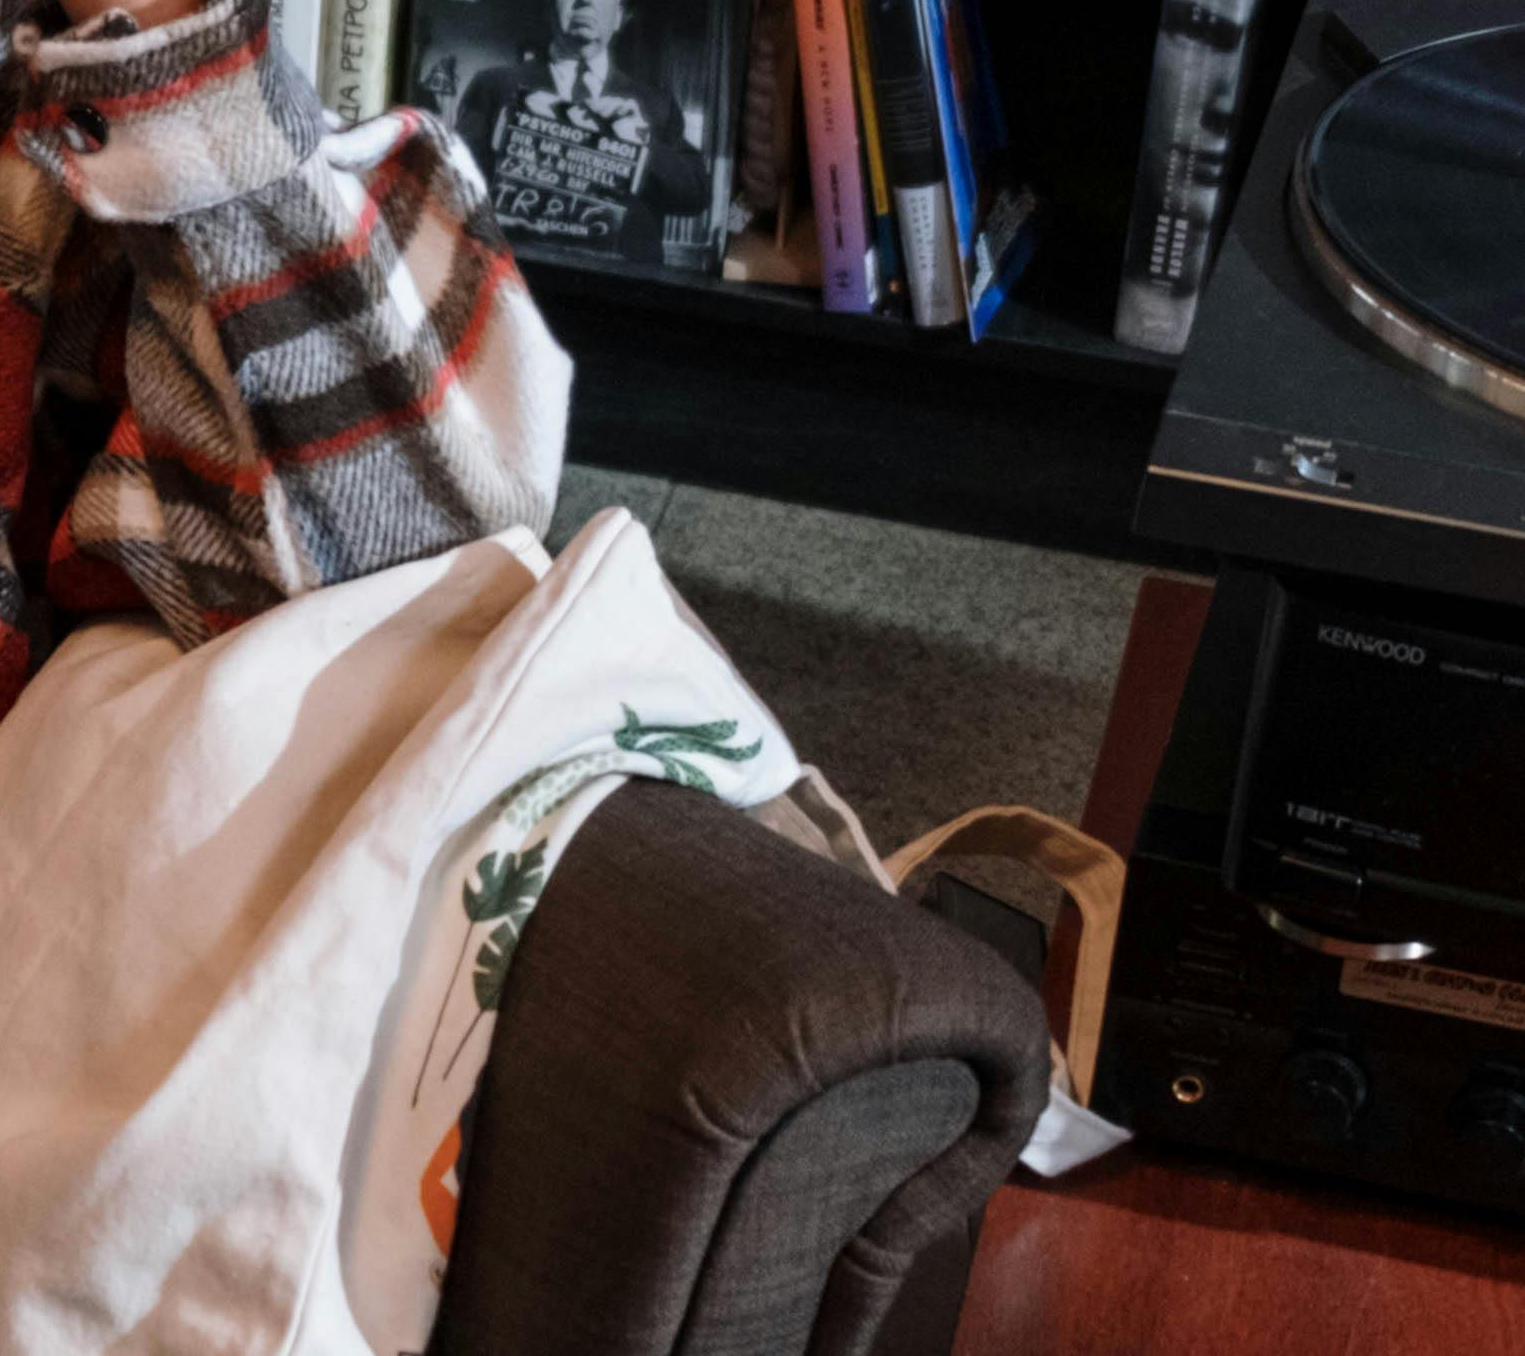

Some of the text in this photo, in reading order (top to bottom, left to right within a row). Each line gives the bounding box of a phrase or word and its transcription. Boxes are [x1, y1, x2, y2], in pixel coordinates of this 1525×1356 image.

[556, 159, 616, 187] RUSSELL
[536, 218, 590, 236] TASCHEN
[1316, 622, 1428, 666] KENWOOD
